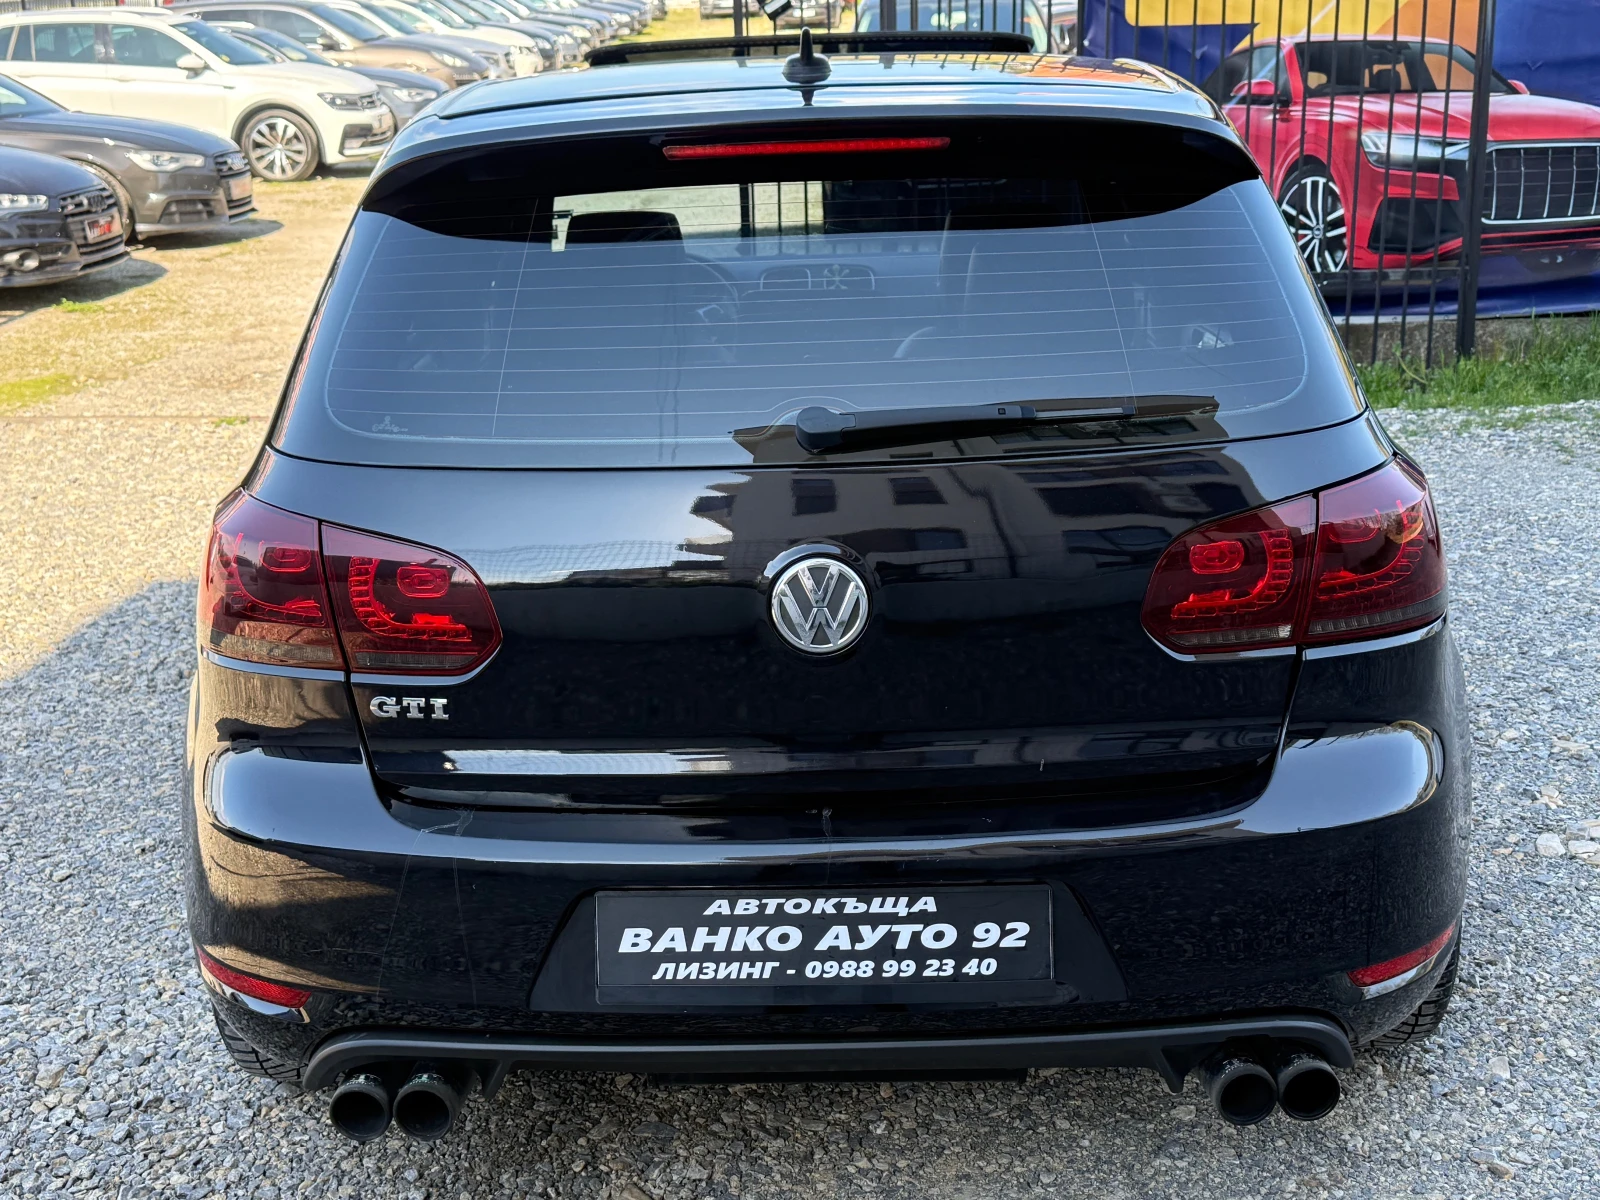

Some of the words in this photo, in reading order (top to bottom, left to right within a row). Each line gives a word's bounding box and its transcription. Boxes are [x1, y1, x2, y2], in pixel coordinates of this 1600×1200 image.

[777, 562, 863, 648] VW
[369, 695, 450, 720] GTI
[702, 896, 938, 917] АВТОКЪЩА
[617, 925, 803, 954] ВАНКО
[813, 923, 958, 951] АУТО
[971, 921, 1031, 949] 92
[651, 961, 781, 980] ЛИЗИНГ
[804, 960, 876, 979] 0988
[881, 959, 917, 978] 99
[922, 958, 956, 977] 23
[961, 957, 998, 976] 40
